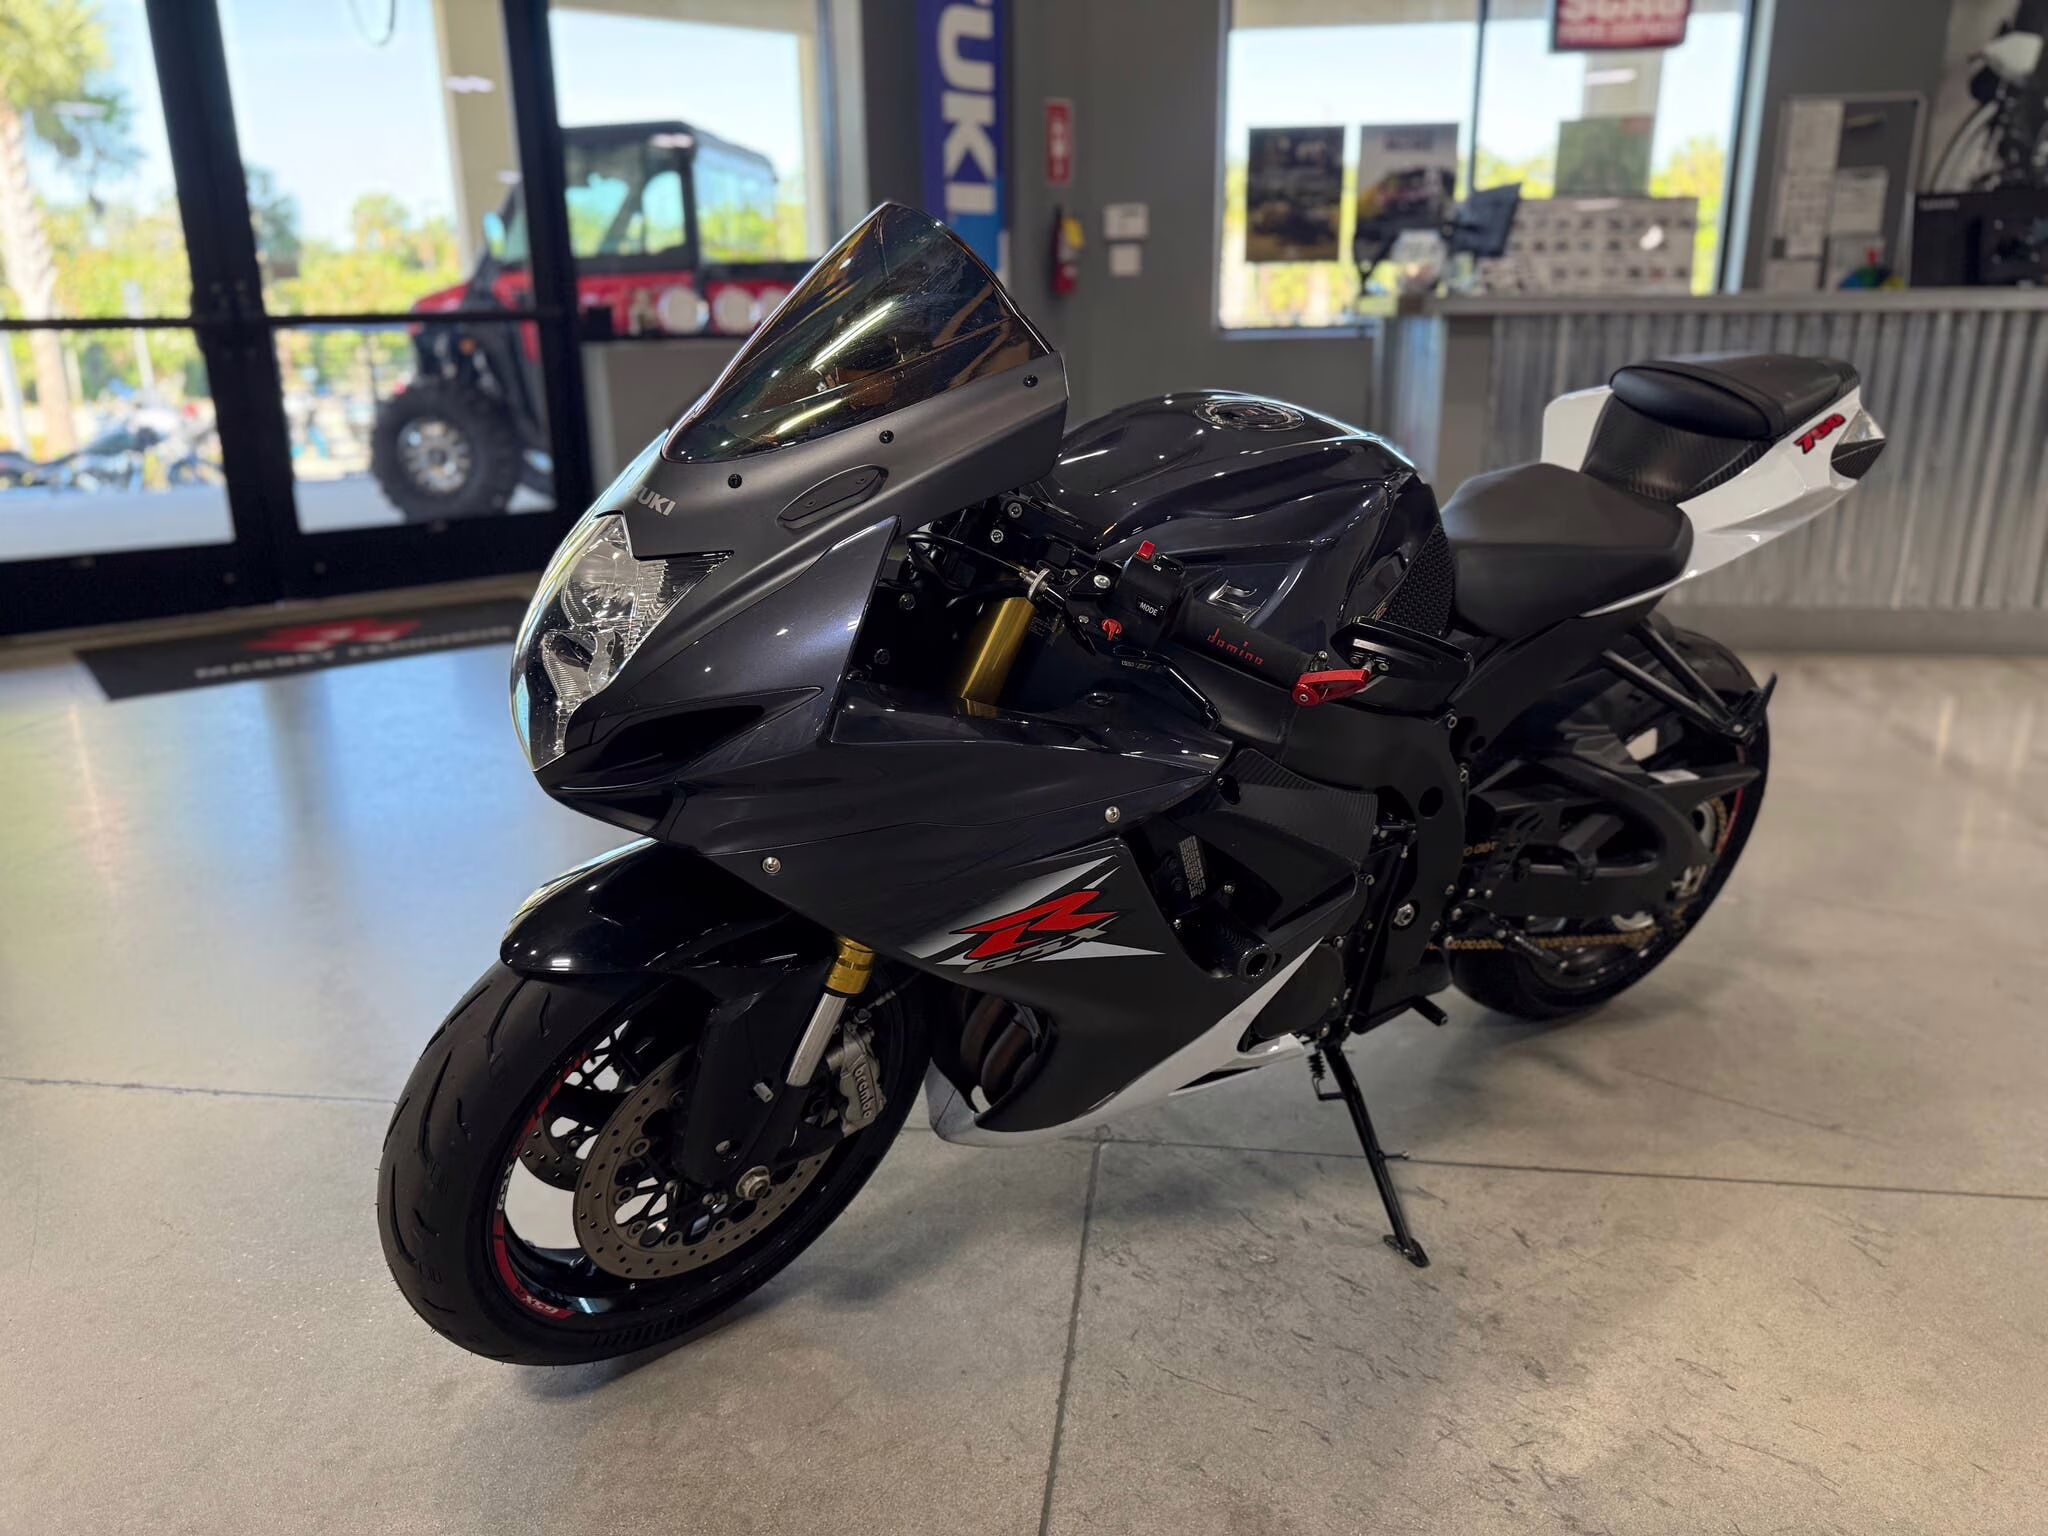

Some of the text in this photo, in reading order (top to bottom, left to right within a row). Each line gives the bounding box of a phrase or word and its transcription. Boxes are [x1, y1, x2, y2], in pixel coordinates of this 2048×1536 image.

[937, 0, 997, 214] UKI
[635, 486, 676, 516] UKI
[1139, 602, 1158, 617] MODE
[1207, 628, 1265, 666] domino
[962, 916, 1120, 974] GSX
[854, 1063, 873, 1119] brembo
